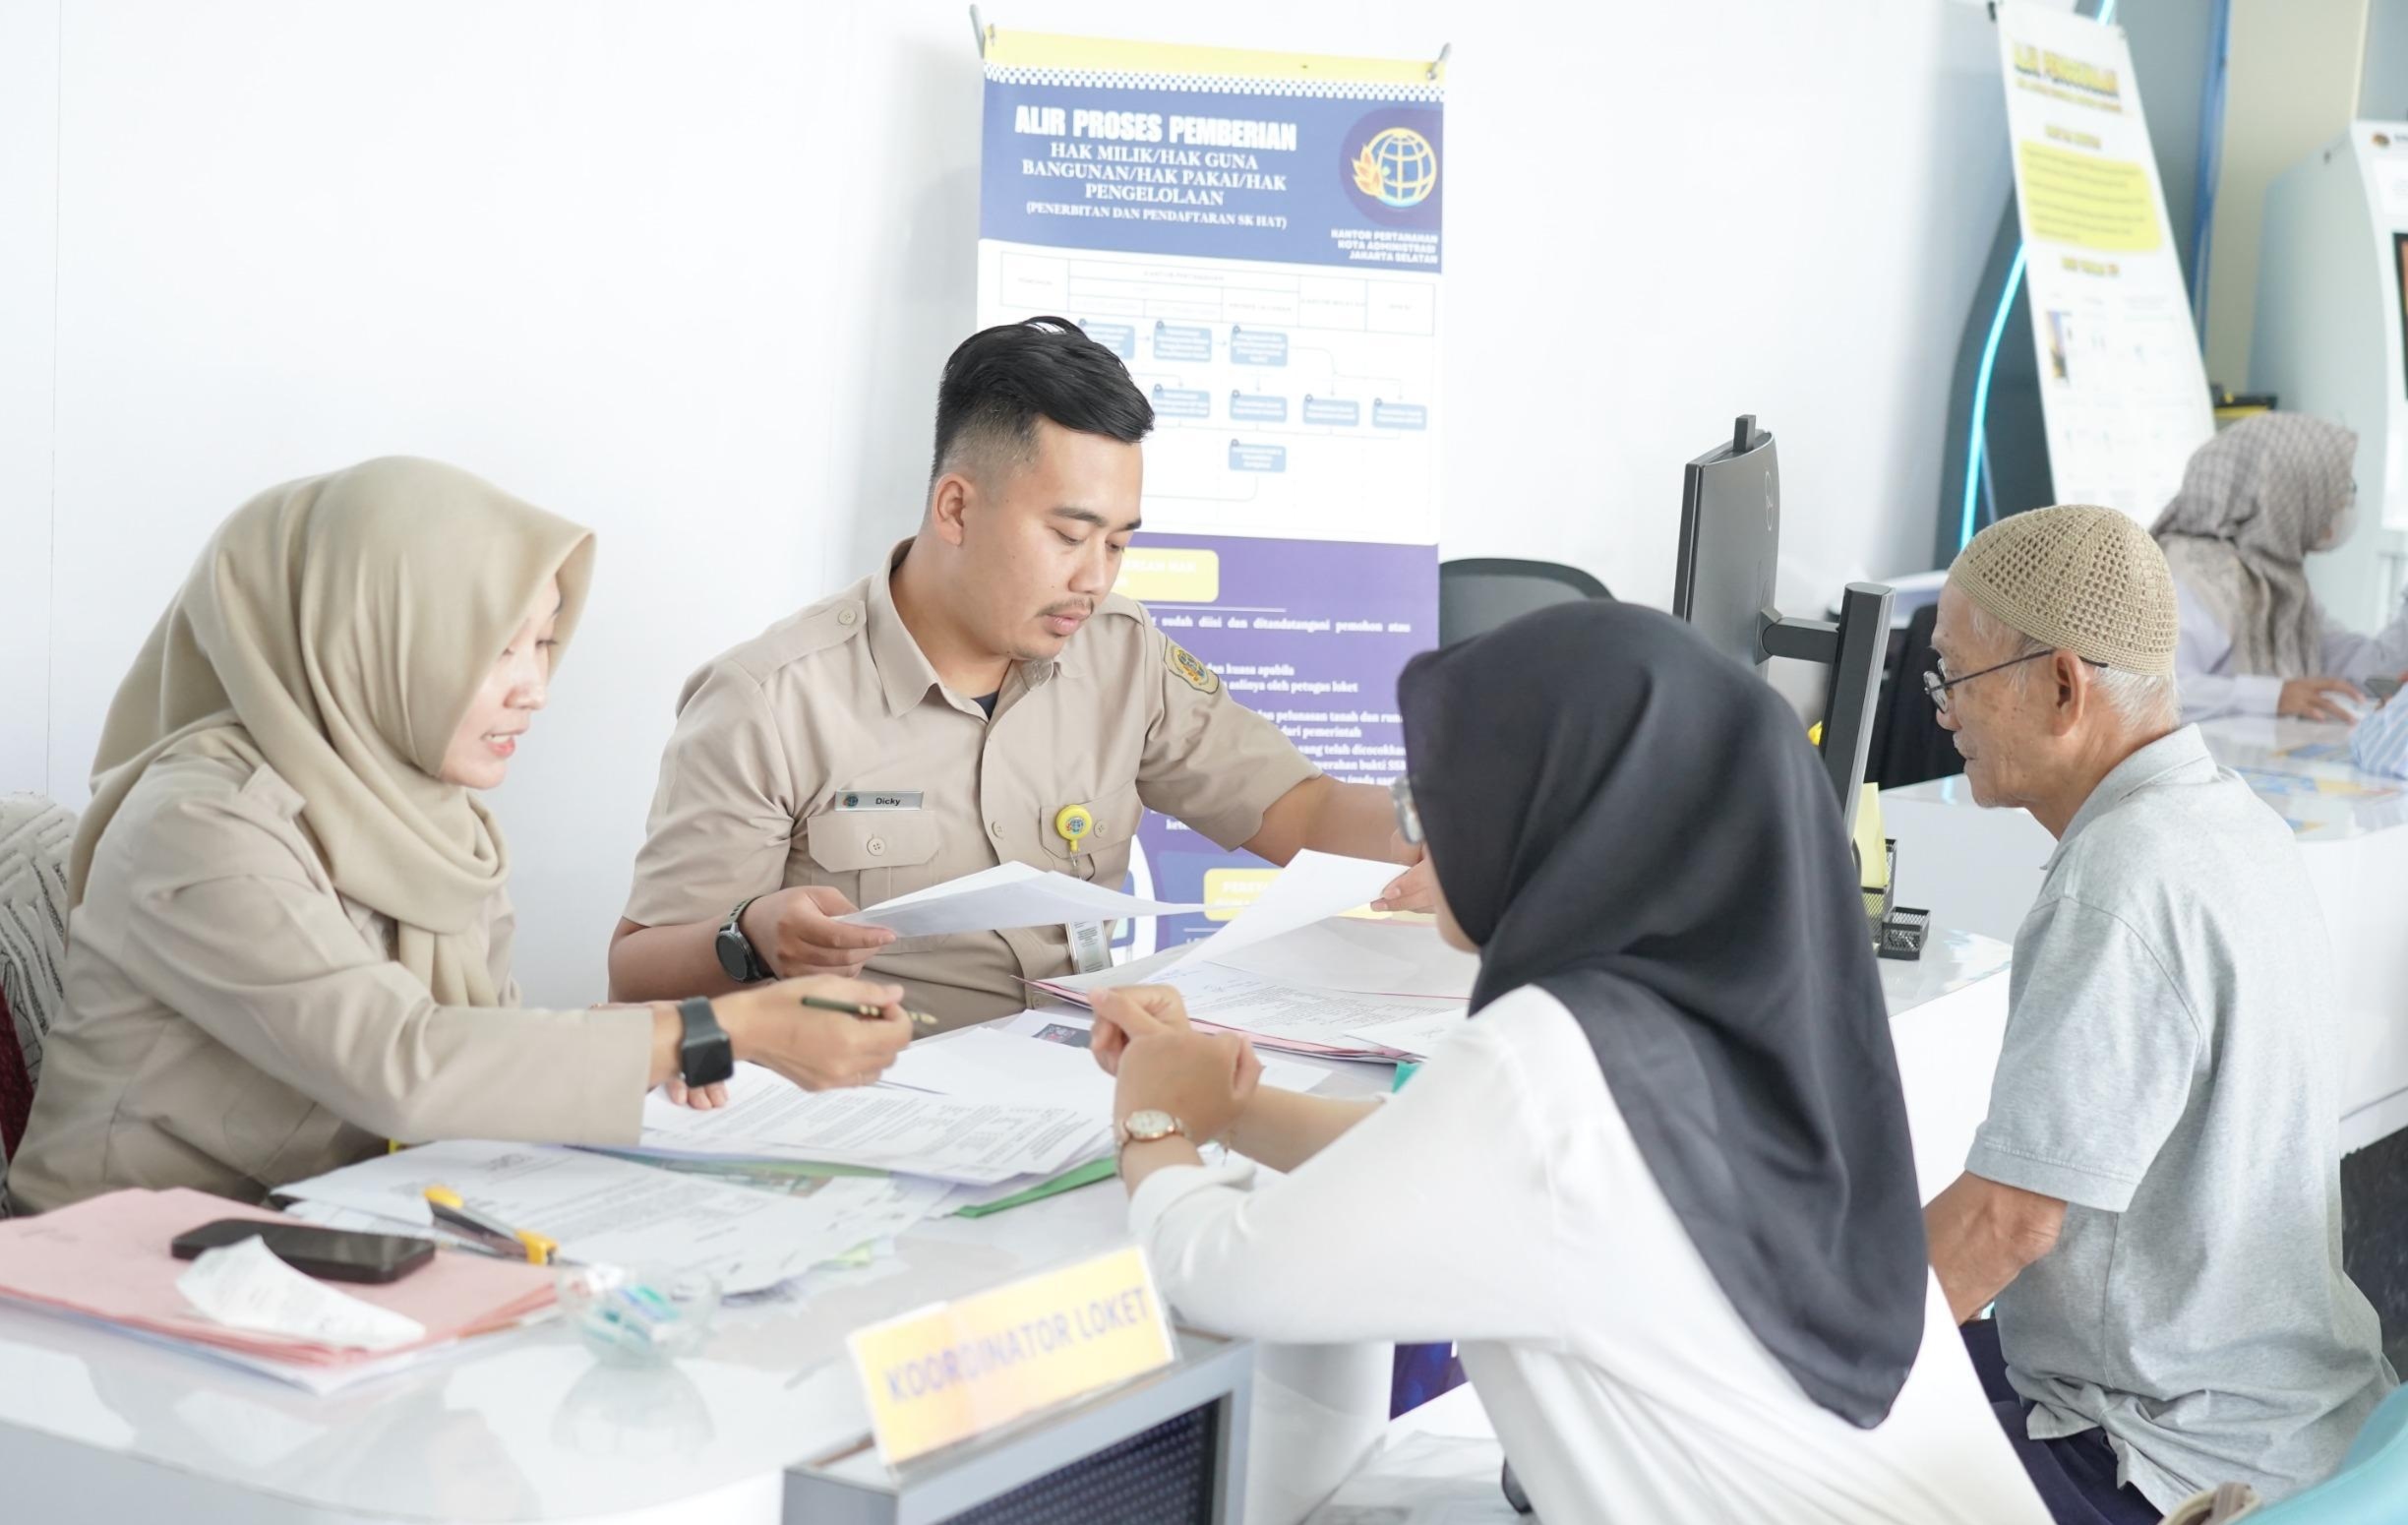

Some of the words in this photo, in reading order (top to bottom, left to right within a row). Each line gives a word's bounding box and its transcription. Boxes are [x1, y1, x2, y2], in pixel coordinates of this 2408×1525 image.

[1014, 104, 1066, 137] ALIR
[1072, 108, 1163, 143] PROSES
[1169, 115, 1297, 152] PEMBERIAN
[1051, 142, 1093, 159] HAK
[1097, 145, 1202, 167] MILIK/HAK
[1205, 152, 1259, 170] GUNA
[1022, 159, 1179, 184] BANGUNAN/HAK
[1182, 169, 1288, 192] PAKAI/HAK
[1085, 183, 1225, 206] PENGELOLAAN
[1026, 201, 1111, 217] (PENERBITAN
[1113, 207, 1140, 219] DAN
[1142, 208, 1236, 225] PENDAFTARAN
[1237, 214, 1254, 226] SK
[1256, 215, 1288, 230] HAT)
[1227, 616, 1248, 629] dan
[875, 797, 901, 807] Dicky
[886, 1312, 1072, 1402] KOORDINATOR
[1076, 1287, 1149, 1340] LOKET
